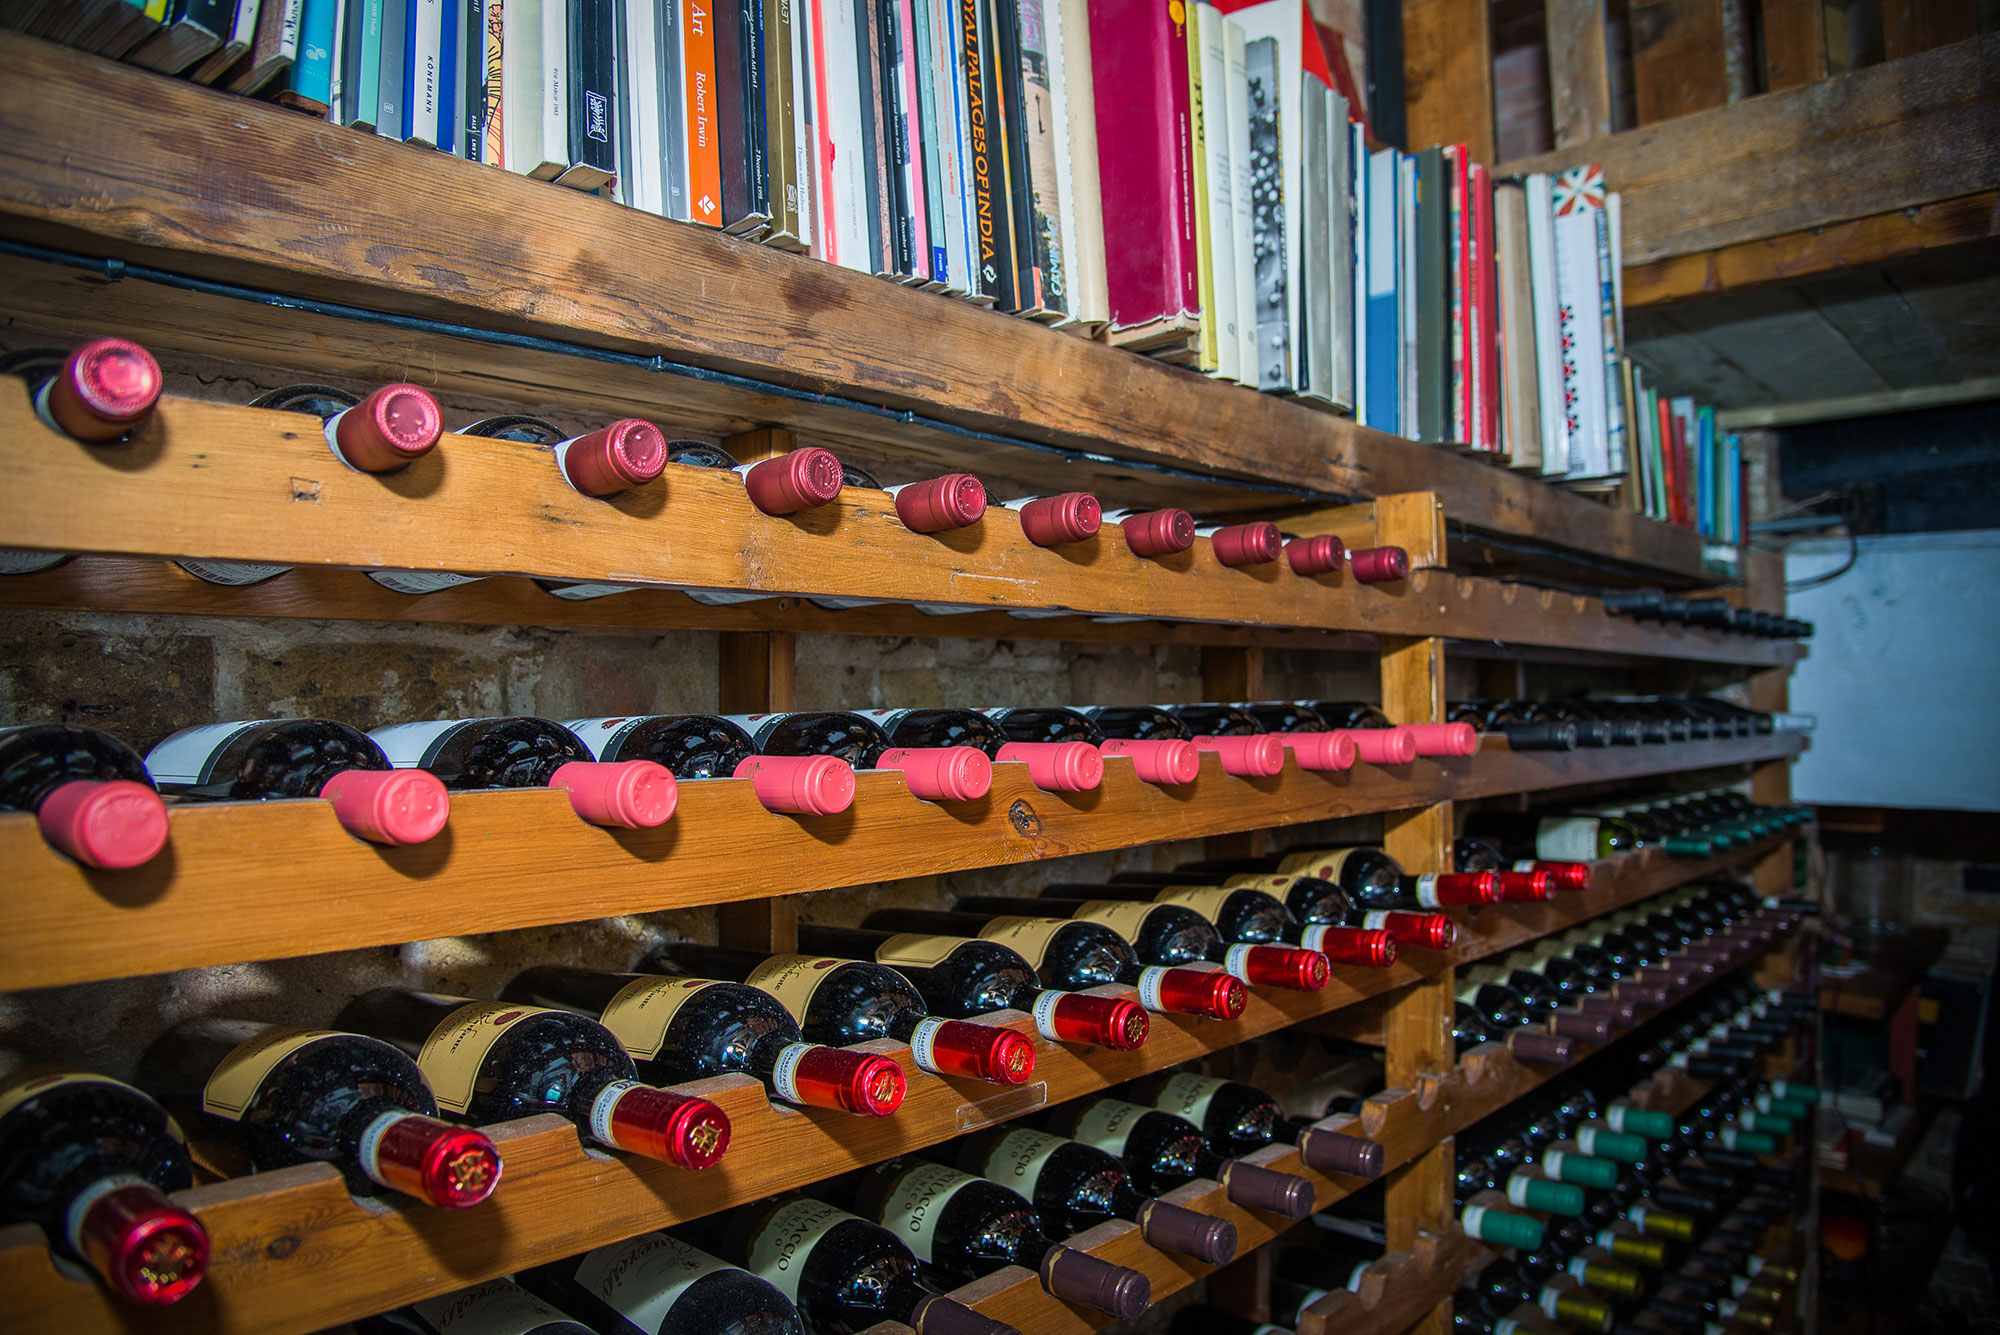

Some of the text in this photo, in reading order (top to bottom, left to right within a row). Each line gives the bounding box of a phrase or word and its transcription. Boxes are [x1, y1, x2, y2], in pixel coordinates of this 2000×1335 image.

[425, 55, 435, 114] KÖNEMANN
[691, 2, 709, 147] Art Robert Irwin
[966, 49, 987, 153] PALACES
[975, 155, 990, 188] OF
[977, 189, 996, 261] INDIA
[1046, 215, 1064, 297] CAMINHO
